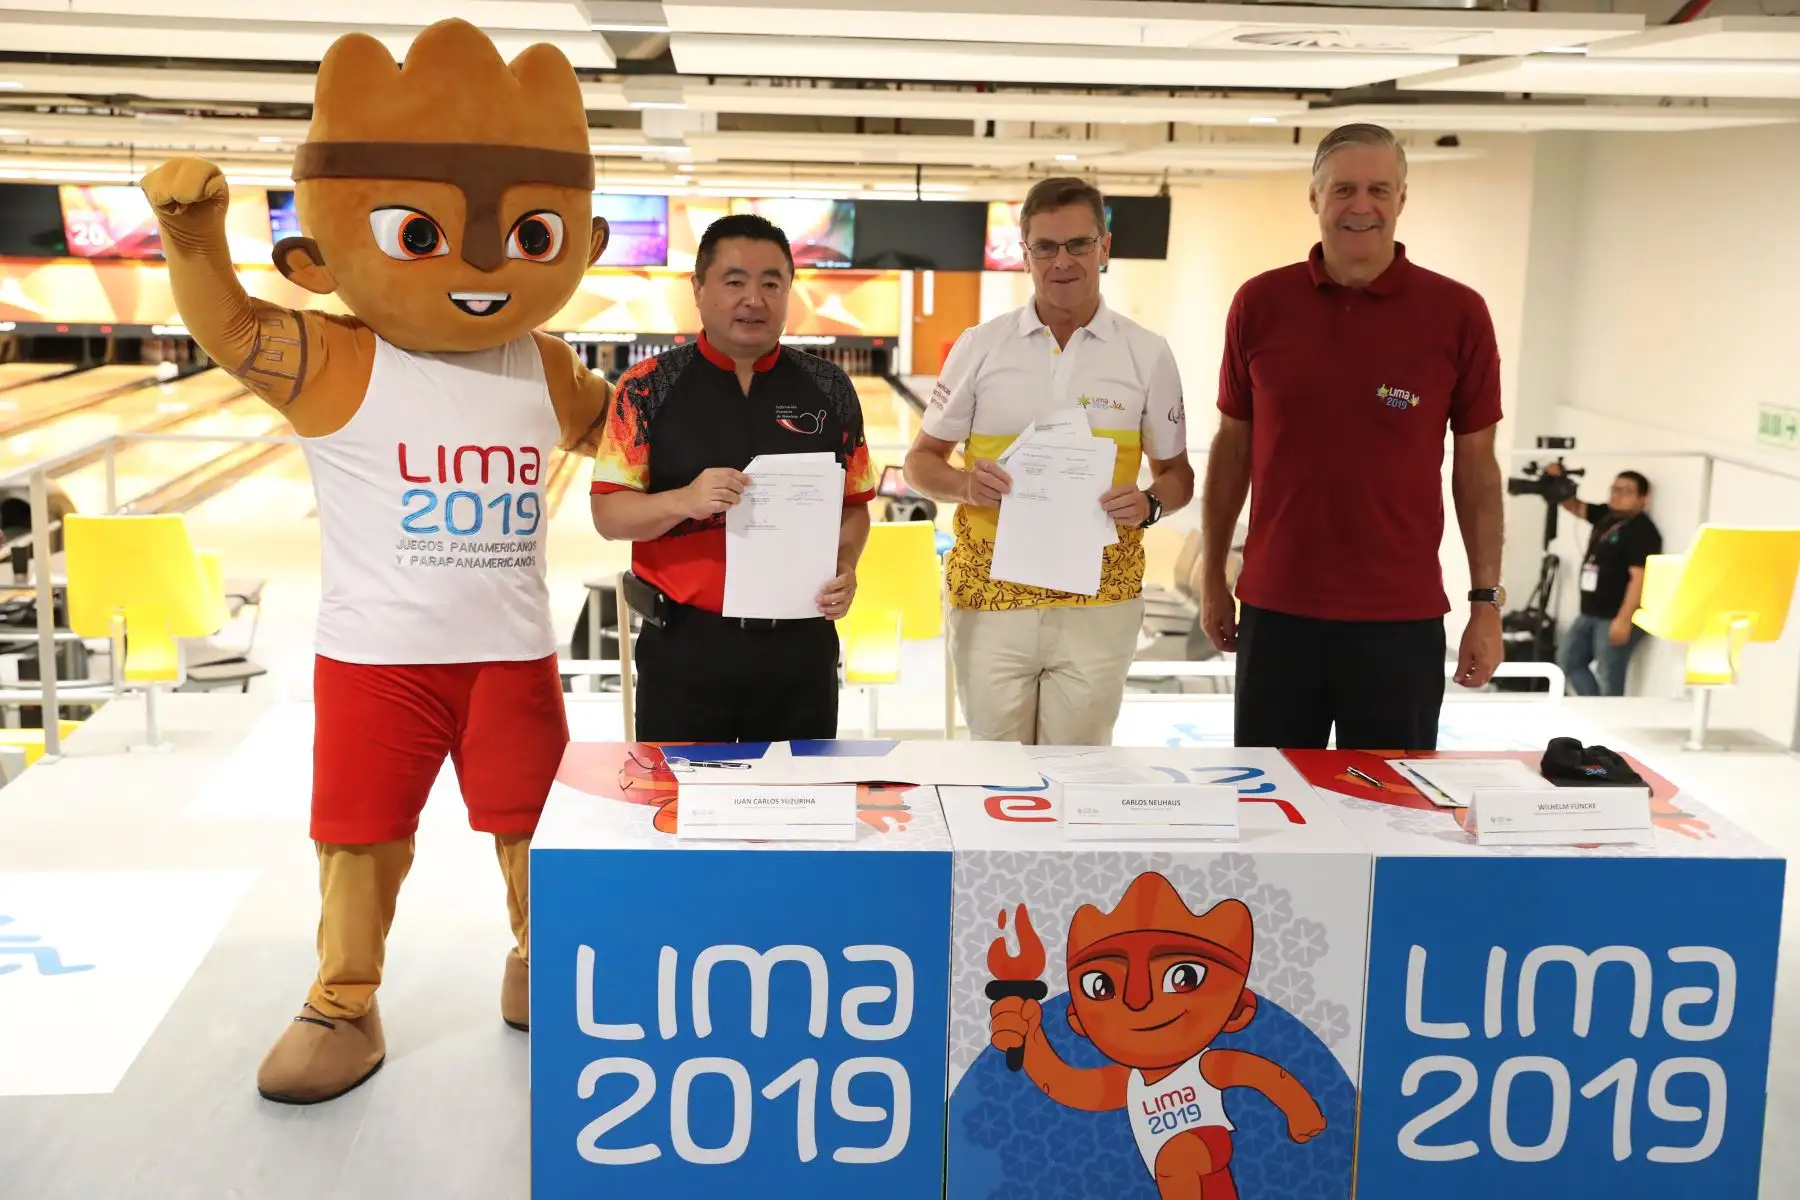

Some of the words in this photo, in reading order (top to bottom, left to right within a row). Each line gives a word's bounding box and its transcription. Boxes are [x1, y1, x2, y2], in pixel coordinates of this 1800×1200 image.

[1389, 387, 1410, 400] Lima
[1386, 396, 1408, 410] 2019
[401, 488, 541, 536] 2019
[396, 539, 444, 552] JUEGOS
[449, 540, 538, 554] PANAMERICANOS
[396, 555, 404, 566] Y
[409, 555, 537, 569] PARAPANAMERICANOS
[1537, 802, 1569, 811] WILHELM
[576, 1056, 912, 1165] 2019
[1397, 1055, 1727, 1163] 2019
[1148, 1103, 1202, 1135] 2019
